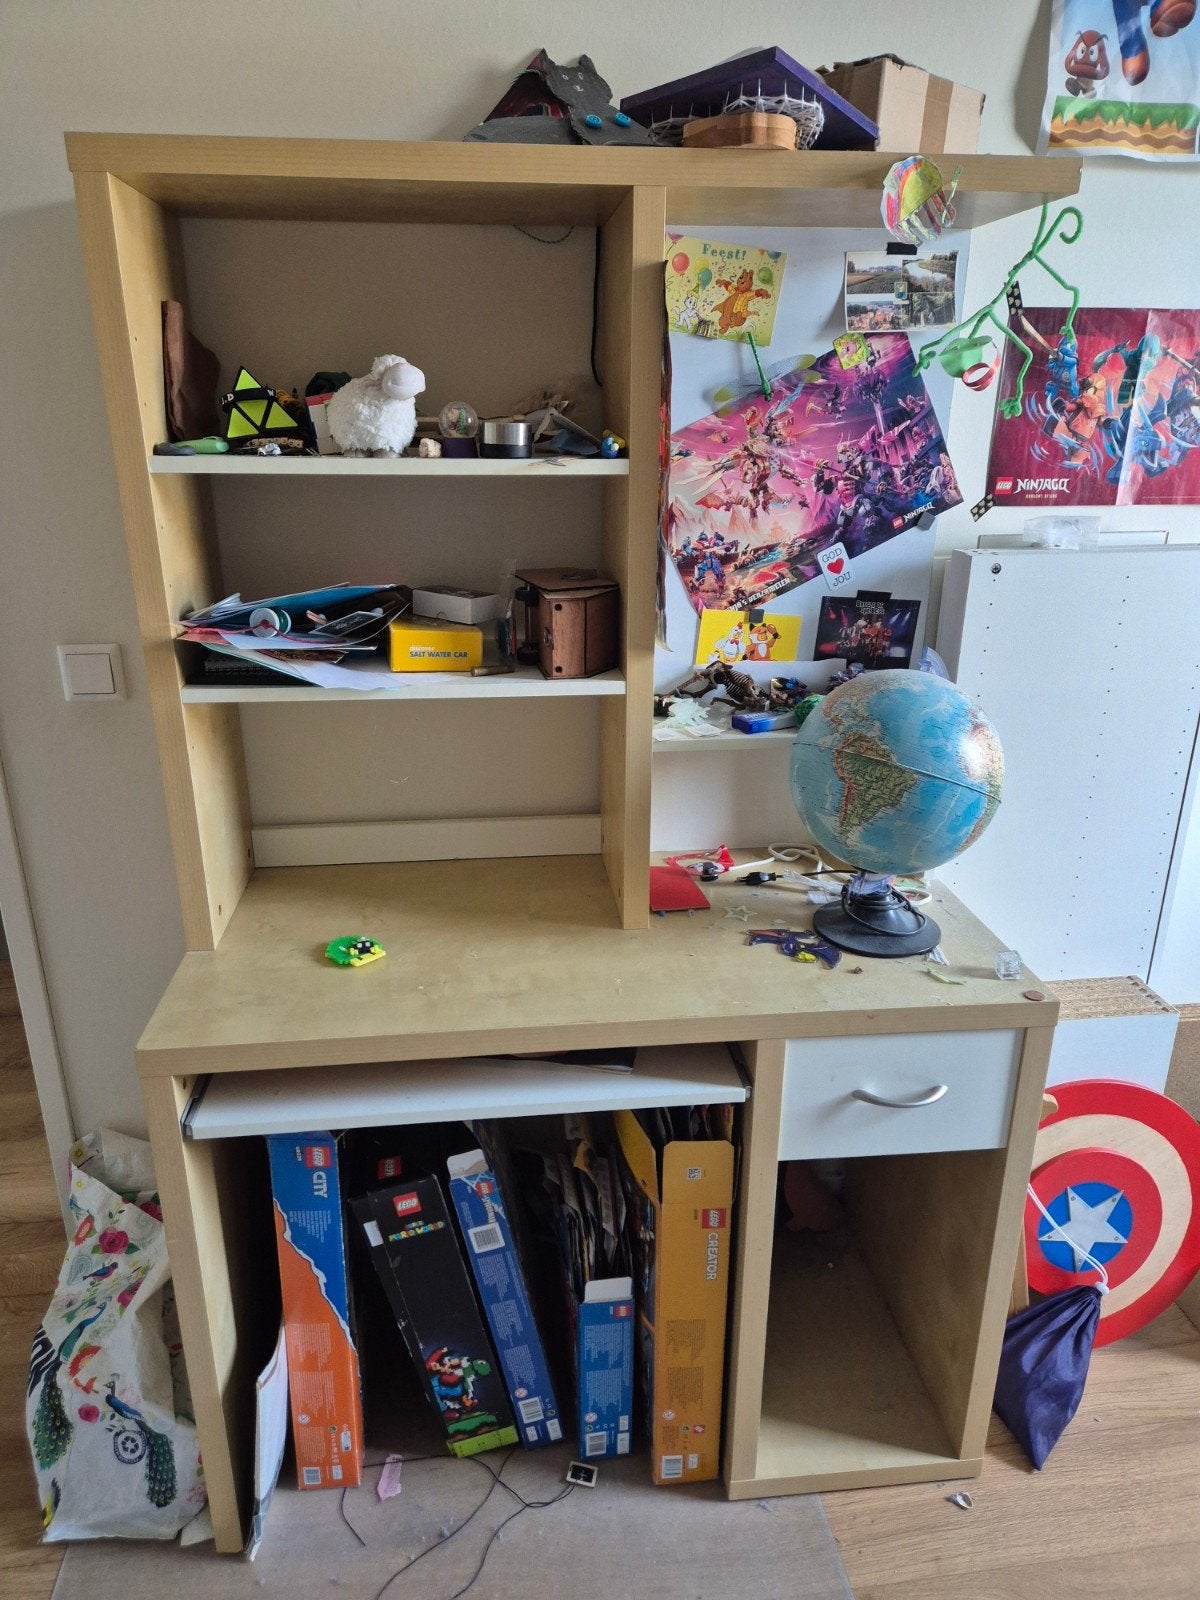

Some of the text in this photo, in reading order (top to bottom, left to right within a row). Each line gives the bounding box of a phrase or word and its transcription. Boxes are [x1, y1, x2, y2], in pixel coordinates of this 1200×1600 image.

[702, 243, 747, 260] Feest!
[1013, 478, 1071, 494] NINJAGO
[903, 501, 936, 523] NINJAGO
[821, 547, 843, 563] GOD
[833, 571, 851, 587] JOU
[312, 1170, 328, 1198] CITY
[388, 1221, 444, 1242] MARIO WORLD
[706, 1232, 719, 1281] CREATOR
